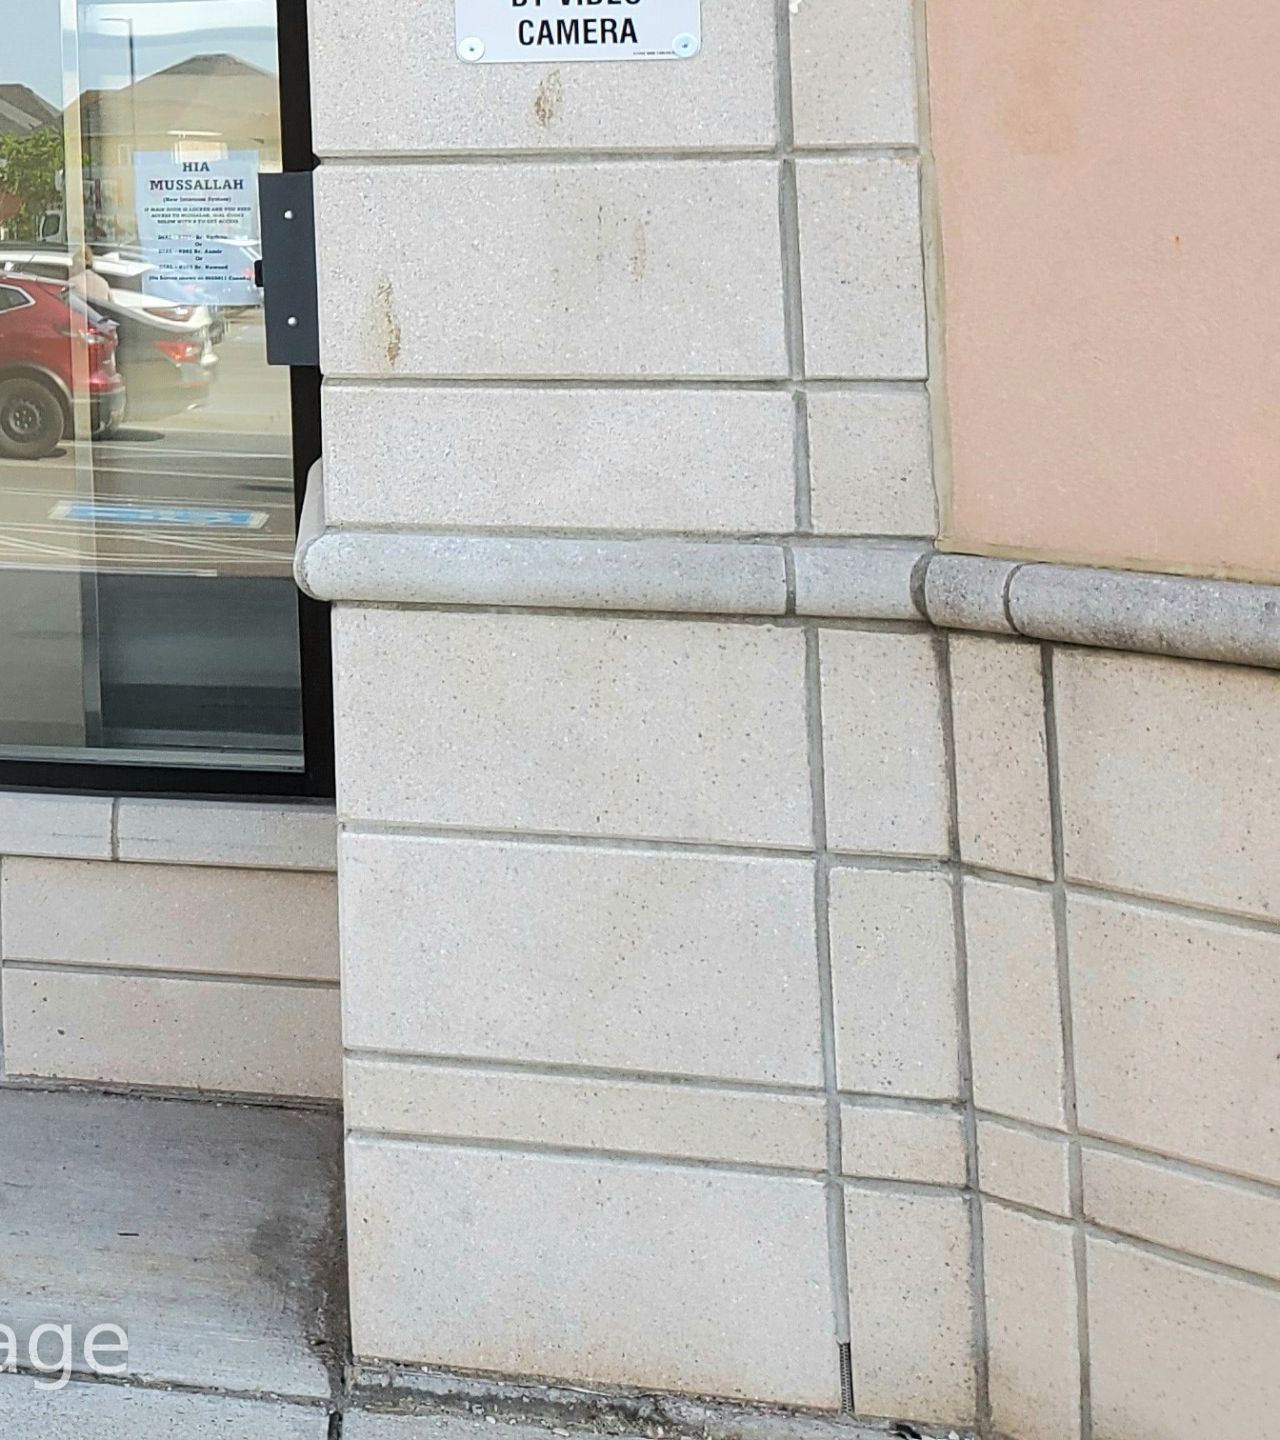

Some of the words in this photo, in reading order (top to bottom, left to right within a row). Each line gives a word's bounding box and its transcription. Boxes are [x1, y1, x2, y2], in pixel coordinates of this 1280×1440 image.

[518, 18, 638, 46] CAMERA
[182, 162, 210, 172] HIA
[150, 179, 244, 190] MUSSALLAH
